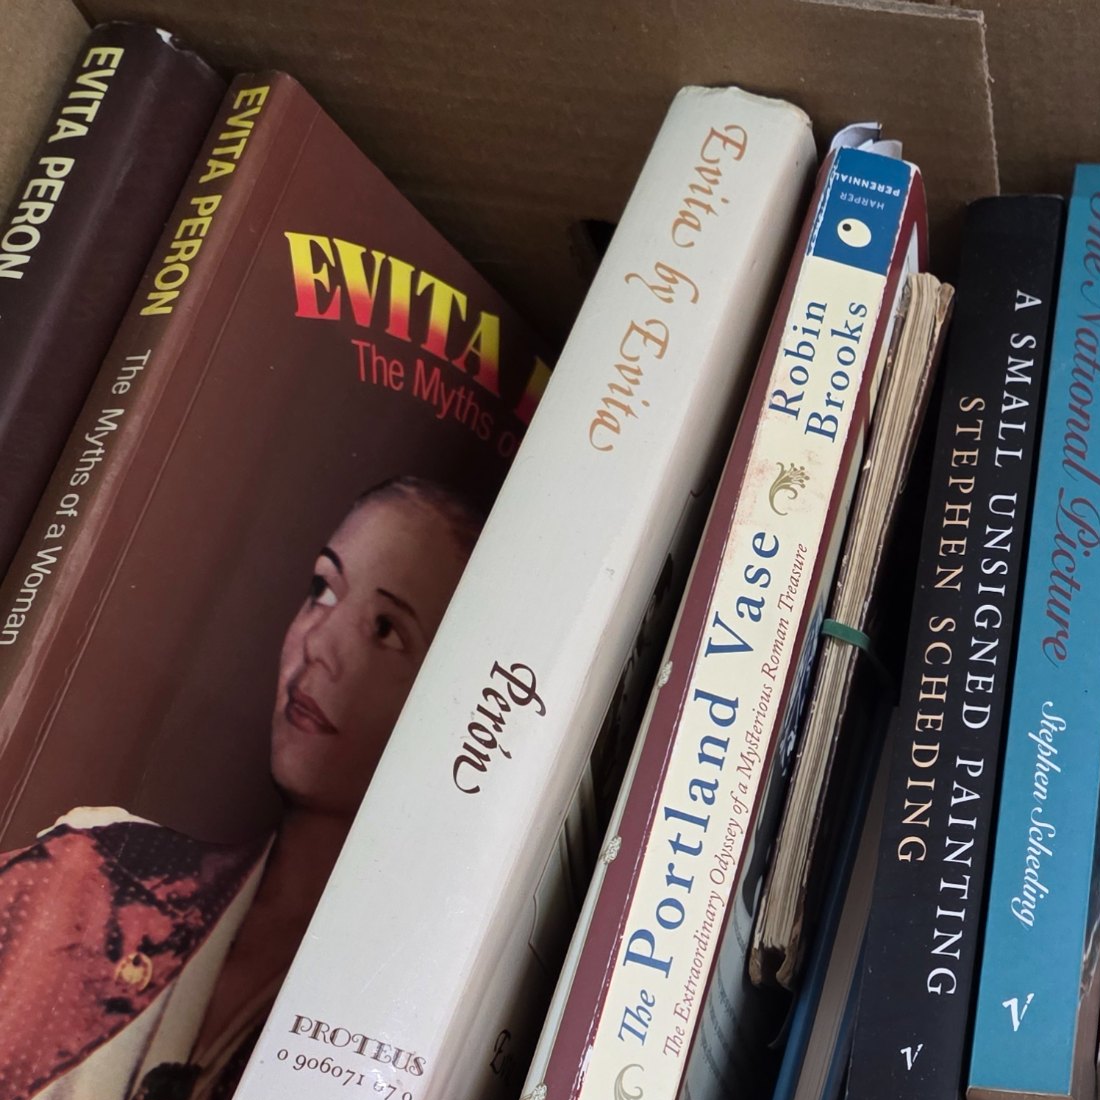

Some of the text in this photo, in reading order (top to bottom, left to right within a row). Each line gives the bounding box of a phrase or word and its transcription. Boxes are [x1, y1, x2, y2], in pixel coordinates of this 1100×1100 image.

[0, 46, 125, 280] EVITA PERON
[835, 172, 901, 197] PERENNIAL
[839, 191, 885, 210] HARPER
[0, 85, 271, 645] EVITA PERON The Myths of Woman
[284, 231, 500, 398] EVITA
[589, 124, 748, 452] Evita by Evita
[768, 302, 828, 421] Robin
[351, 339, 405, 391] The
[412, 358, 494, 440] Myths
[804, 301, 868, 444] Brooks
[897, 395, 985, 864] STEPHEN SCHEDING
[926, 289, 1042, 996] A SMALL UNSIGNED PAINTING
[452, 662, 546, 795] Perón
[617, 531, 779, 1046] The Portland Vase
[674, 543, 807, 1023] Extraordinary Odyssey Mysterious Roman Treasure
[1010, 700, 1067, 929] Stephen Scheding
[288, 1014, 427, 1077] PROTEUS
[293, 1054, 365, 1086] 906071
